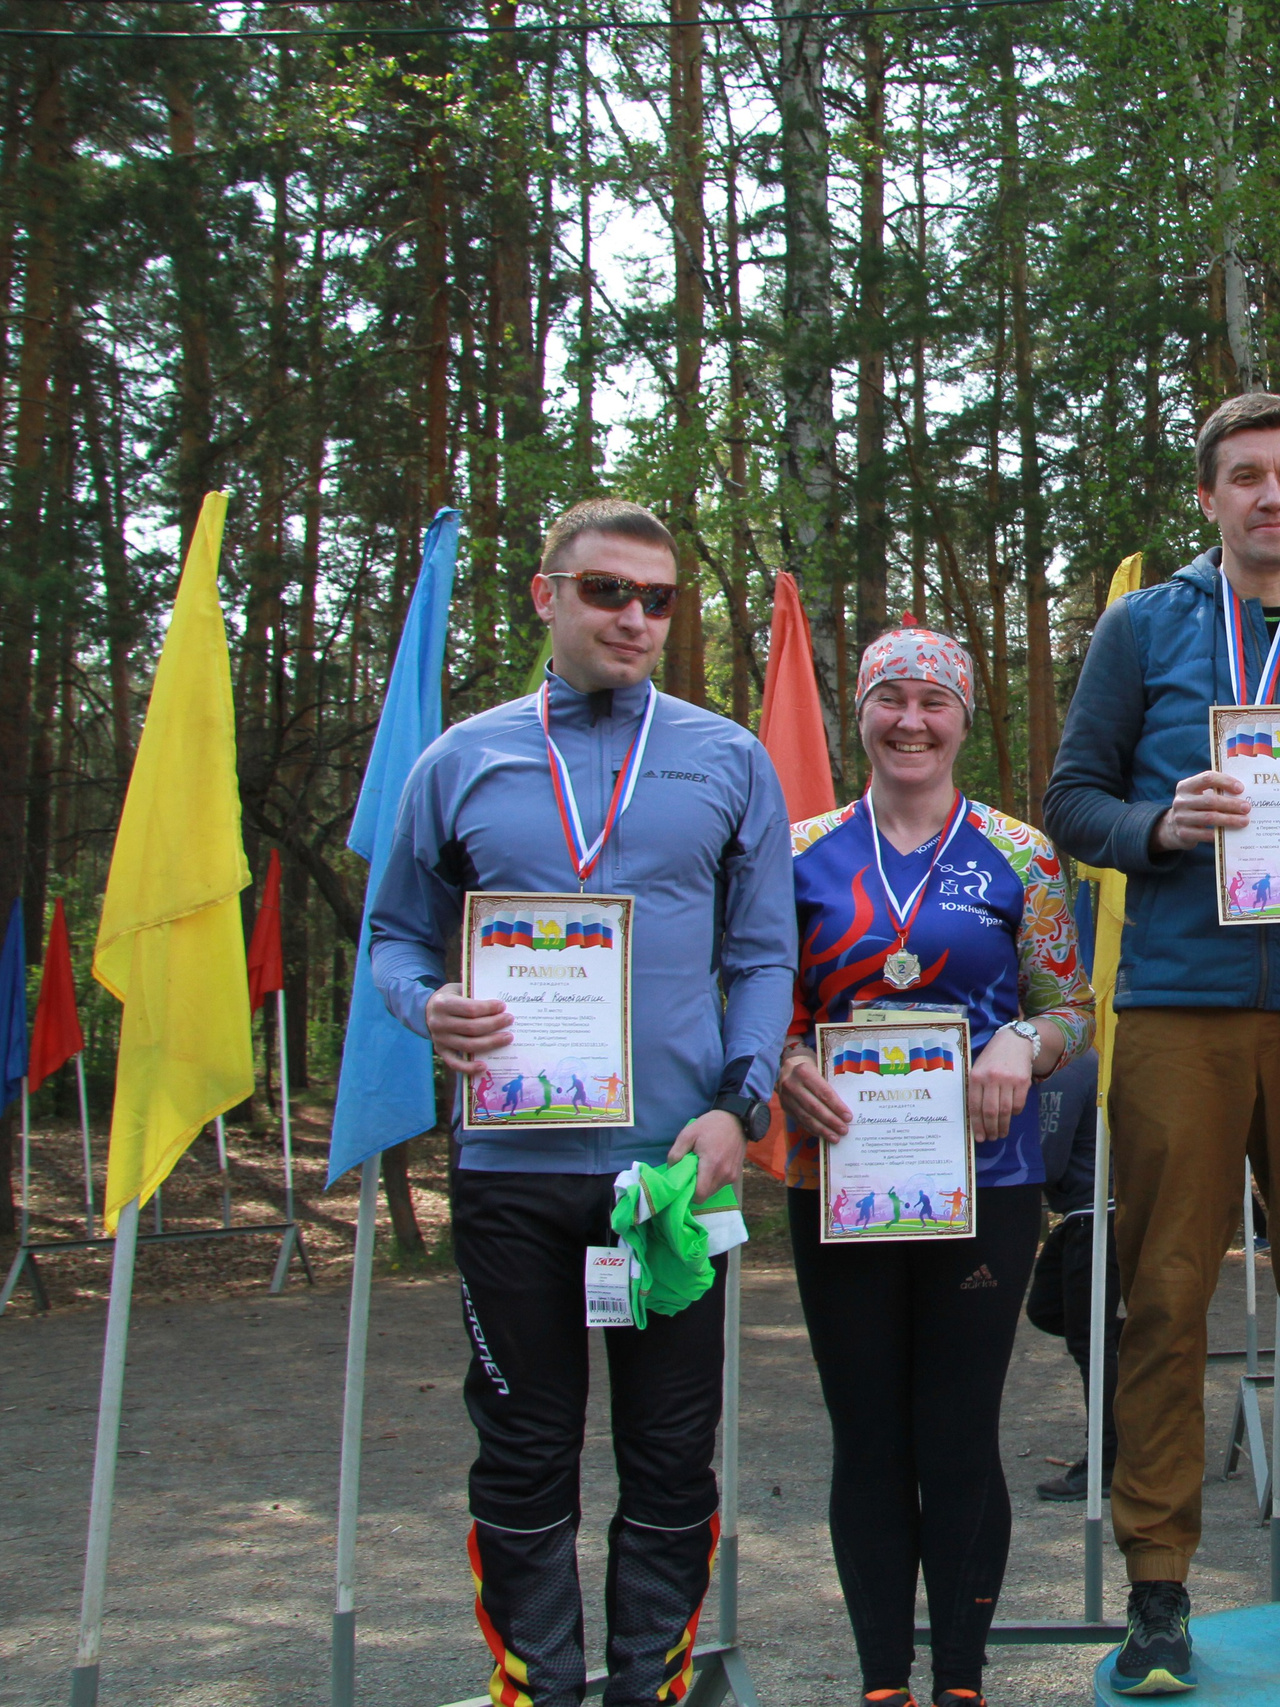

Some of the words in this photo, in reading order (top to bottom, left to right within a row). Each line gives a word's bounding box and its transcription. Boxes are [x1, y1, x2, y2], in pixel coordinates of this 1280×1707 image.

[660, 770, 710, 784] TERREX
[939, 902, 989, 916] Южный
[509, 966, 587, 977] ГРАМОТА
[898, 964, 906, 974] 2
[859, 1089, 931, 1101] ГРАМОТА
[960, 1279, 998, 1290] adidas
[590, 1316, 631, 1324] www.kv2.ch
[462, 1277, 510, 1395] ELTONEN
